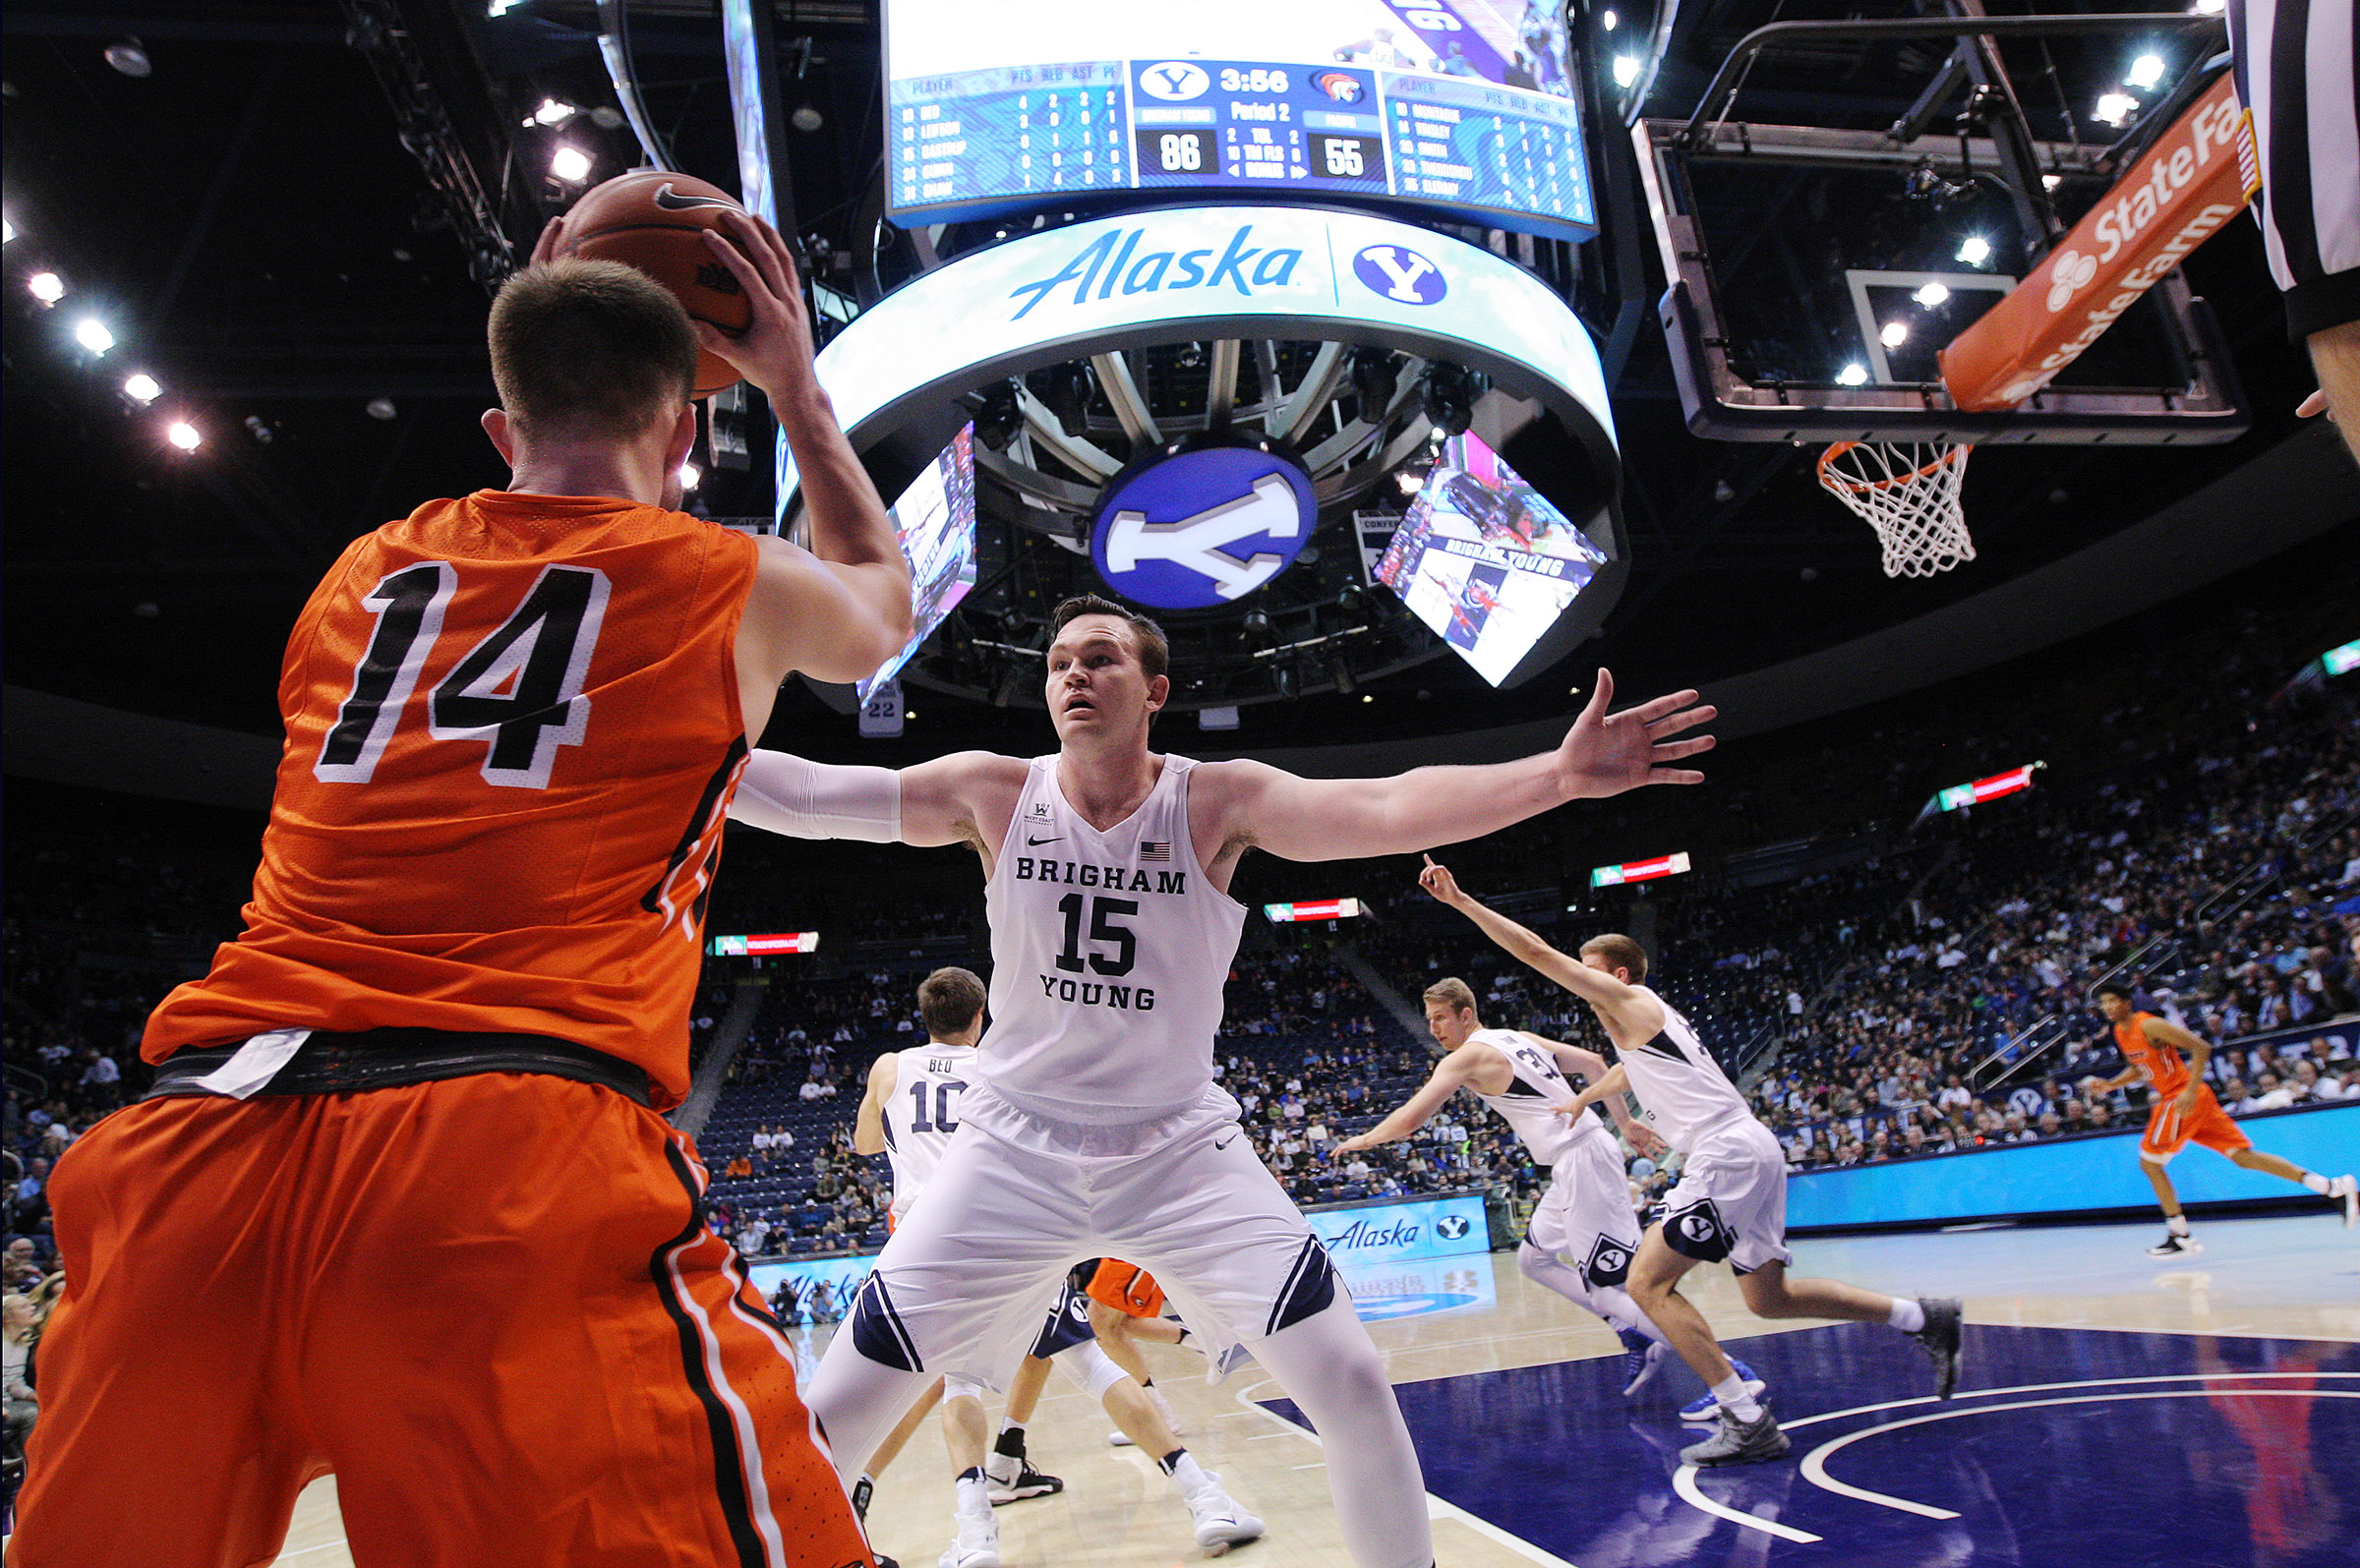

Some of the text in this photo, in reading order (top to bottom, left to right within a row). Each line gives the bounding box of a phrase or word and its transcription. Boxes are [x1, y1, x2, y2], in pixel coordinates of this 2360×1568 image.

[913, 78, 952, 94] PLAYER
[1012, 70, 1032, 83] PTS
[1042, 68, 1063, 81] REB
[1072, 66, 1092, 80] AST
[1154, 69, 1195, 94] Y
[1220, 68, 1289, 93] 3:56
[1400, 78, 1436, 93] PLAYER
[1049, 93, 1058, 108] 2
[1080, 92, 1089, 106] 2
[1106, 90, 1115, 105] 2
[1109, 109, 1116, 124] 1
[1230, 101, 1290, 122] Period 2
[1053, 133, 1059, 147] 1
[1085, 131, 1091, 145] 1
[1109, 130, 1118, 145] 0
[1226, 128, 1237, 143] 2
[1289, 130, 1299, 145] 2
[1493, 116, 1502, 131] 2
[1518, 121, 1526, 135] 1
[1541, 126, 1551, 140] 2
[1564, 131, 1571, 145] 1
[1022, 154, 1031, 169] 0
[1084, 150, 1092, 166] 0
[1110, 149, 1119, 164] 0
[1160, 134, 1202, 171] 86
[1325, 139, 1364, 176] 55
[1521, 139, 1529, 152] 1
[1545, 143, 1552, 157] 1
[1499, 152, 1507, 168] 2
[1524, 157, 1532, 171] 1
[1025, 174, 1031, 189] 1
[1551, 181, 1558, 195] 1
[1504, 190, 1513, 204] 2
[1008, 224, 1436, 321] Alaska Y
[1507, 551, 1564, 577] YOUNG
[313, 560, 612, 790] 14
[868, 702, 894, 717] 22
[1016, 857, 1186, 895] BRIGHAM
[1056, 893, 1139, 977] 15
[1039, 974, 1154, 1011] YOUNG
[929, 1059, 952, 1073] BEO
[910, 1081, 969, 1133] 10
[1325, 1218, 1420, 1251] Alaska
